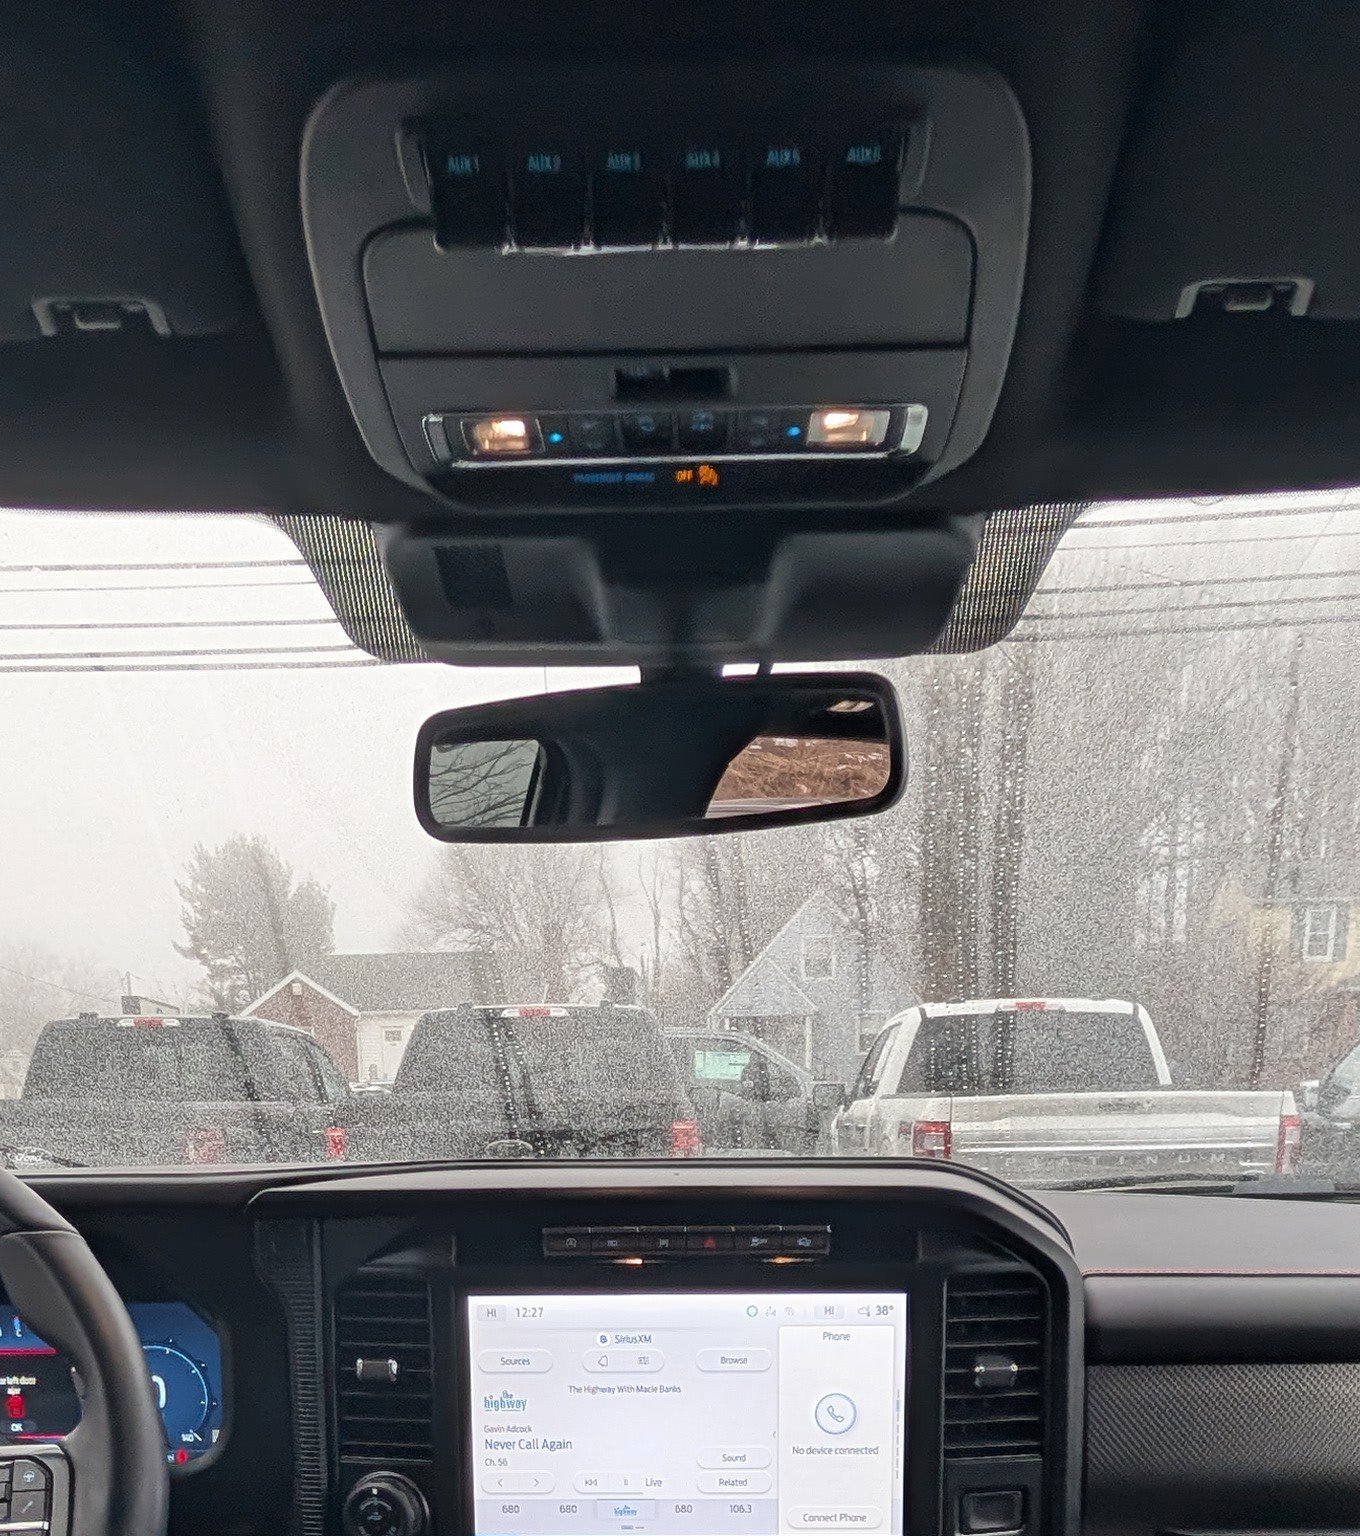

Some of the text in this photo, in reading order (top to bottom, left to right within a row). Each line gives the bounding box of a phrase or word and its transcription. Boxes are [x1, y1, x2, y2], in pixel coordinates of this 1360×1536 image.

[516, 1307, 544, 1318] 12:27
[875, 1305, 894, 1316] 38°
[614, 1334, 653, 1344] SiriusXM
[823, 1332, 851, 1341] Phone
[500, 1357, 531, 1366] Sources
[720, 1356, 748, 1365] Browse
[569, 1385, 582, 1394] The
[583, 1385, 616, 1395] Highway
[617, 1385, 635, 1394] With
[483, 1395, 527, 1411] highway
[11, 1423, 23, 1432] OK
[483, 1425, 505, 1433] Gavin
[484, 1439, 573, 1452] Never Call Again
[792, 1446, 879, 1455] No device connected
[722, 1454, 746, 1463] Sound
[645, 1478, 662, 1488] Live
[718, 1478, 748, 1487] Related
[502, 1505, 520, 1514] 680
[559, 1505, 578, 1514] 680
[803, 1513, 867, 1522] Connect Phone
